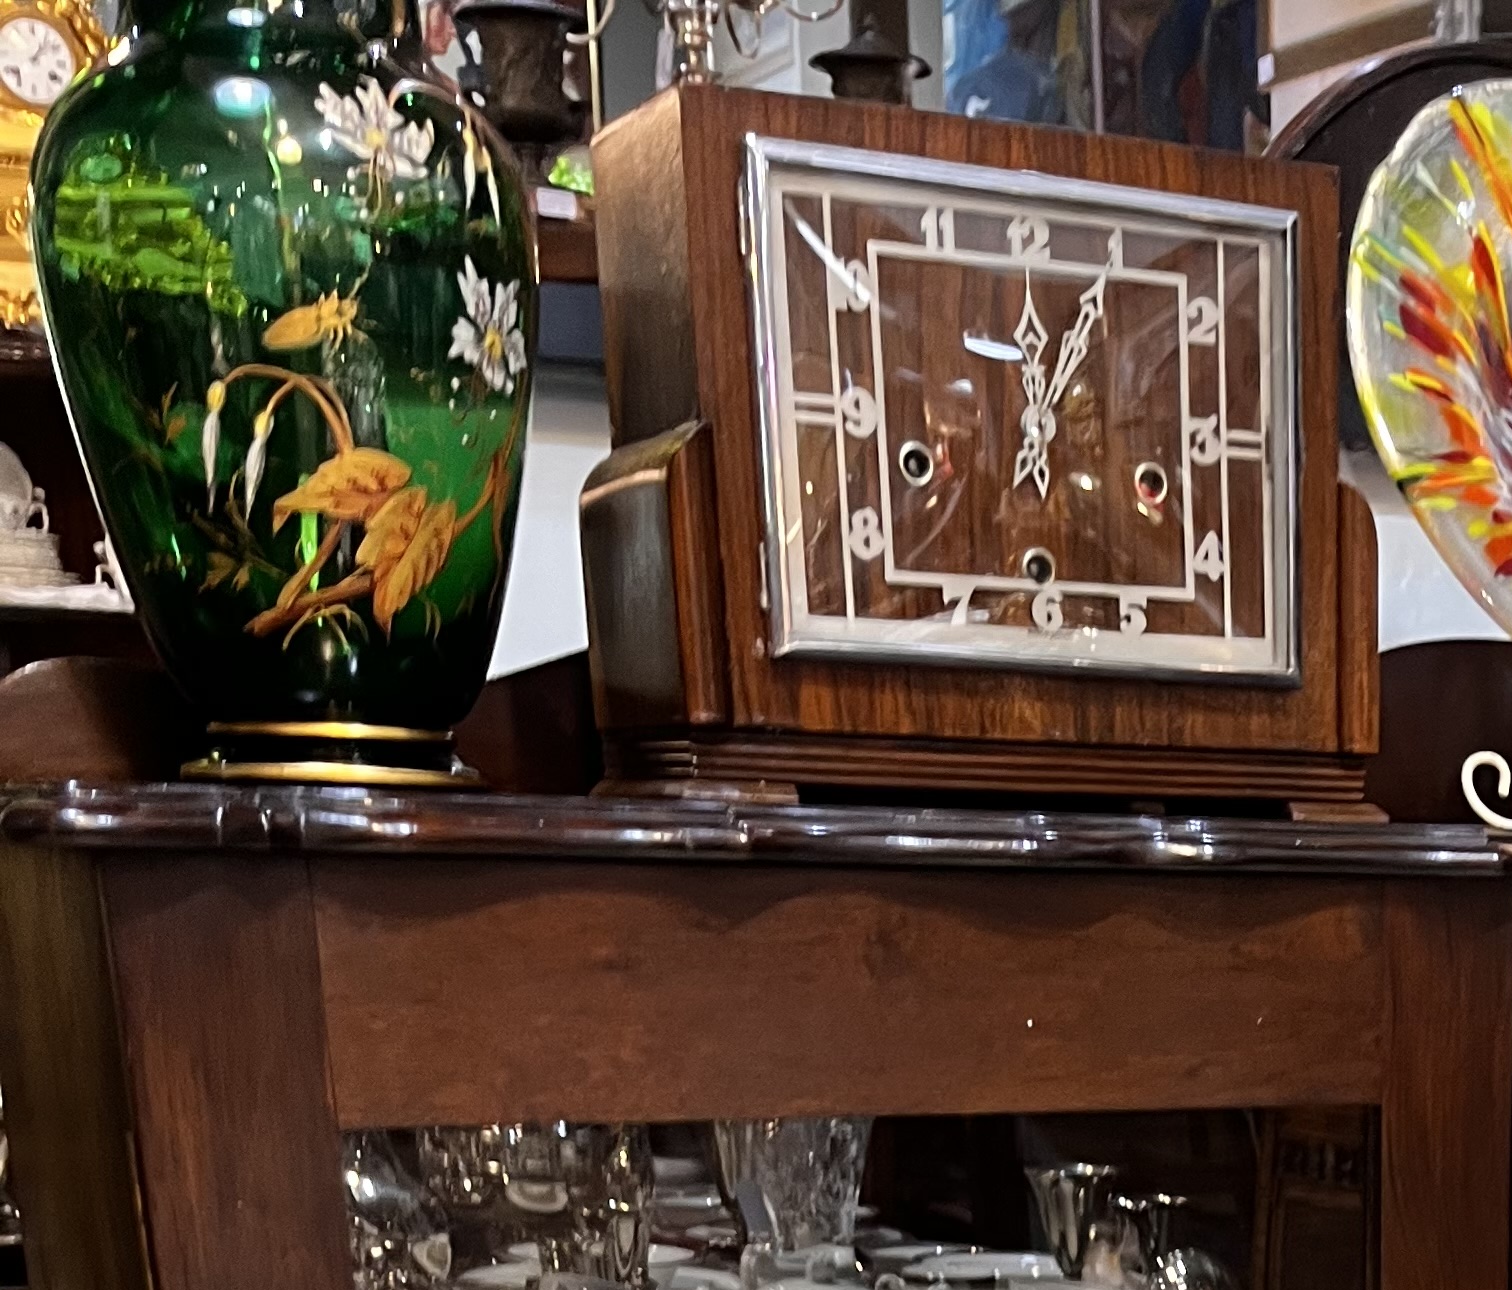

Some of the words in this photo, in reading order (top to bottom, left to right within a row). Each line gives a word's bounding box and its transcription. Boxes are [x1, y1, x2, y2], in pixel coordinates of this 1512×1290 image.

[921, 204, 956, 252] 11
[1006, 213, 1050, 264] 12
[1187, 296, 1218, 345] 2
[841, 385, 877, 438] 9
[1189, 413, 1221, 466] 3
[850, 505, 885, 560] 8
[1193, 530, 1224, 582] 4
[942, 583, 976, 625] 7
[1031, 587, 1063, 634] 6
[1119, 590, 1147, 635] 5
